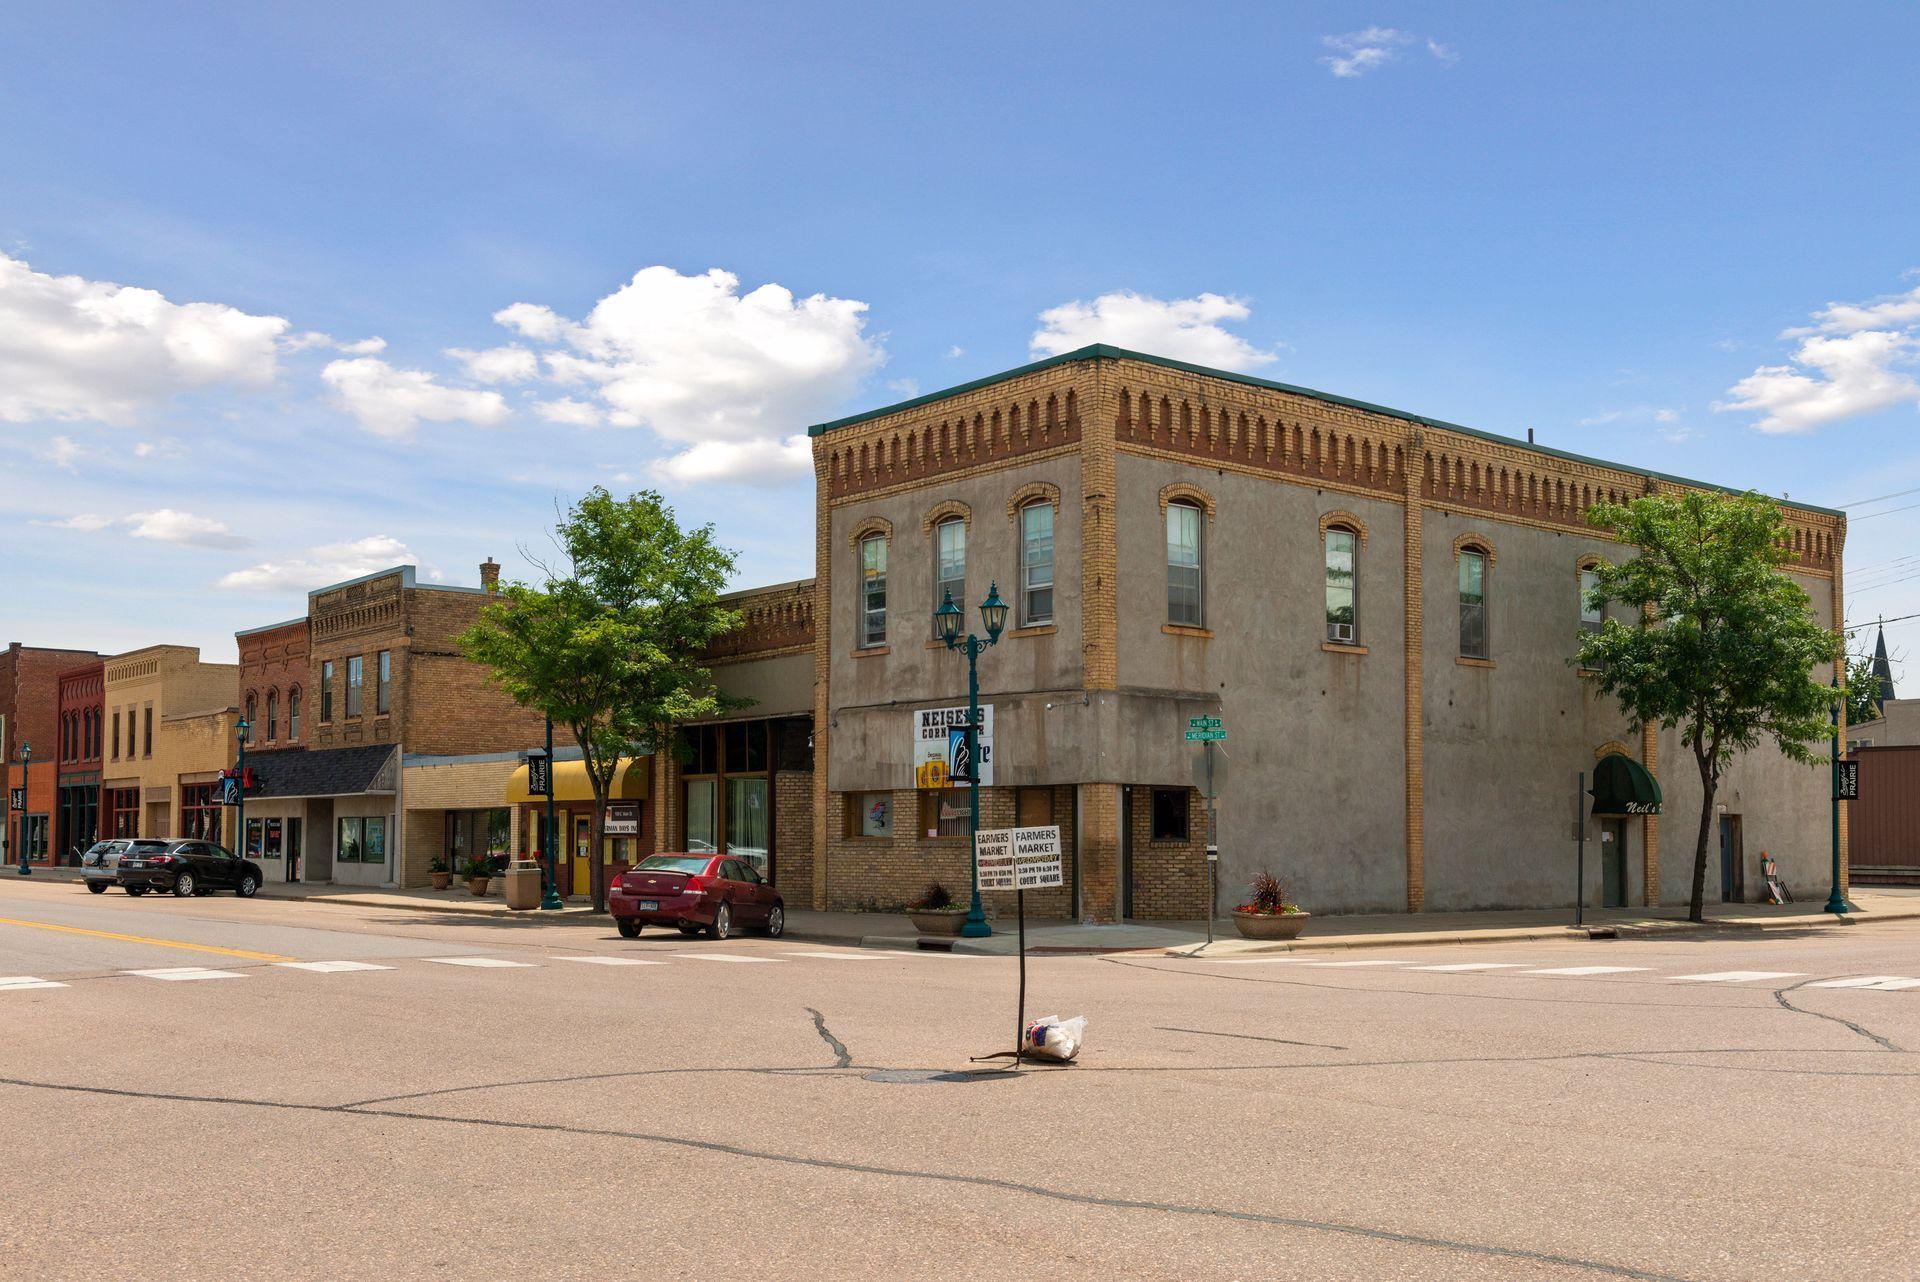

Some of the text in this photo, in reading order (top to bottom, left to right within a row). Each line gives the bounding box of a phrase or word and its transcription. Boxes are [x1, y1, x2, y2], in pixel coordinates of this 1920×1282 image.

[1625, 801, 1656, 813] Neil's
[977, 833, 1009, 844] FARMERS
[1015, 829, 1056, 842] FARMERS
[979, 846, 1008, 856] MARKET
[1018, 842, 1054, 854] MARKET
[1019, 873, 1060, 885] COURT SQUARE
